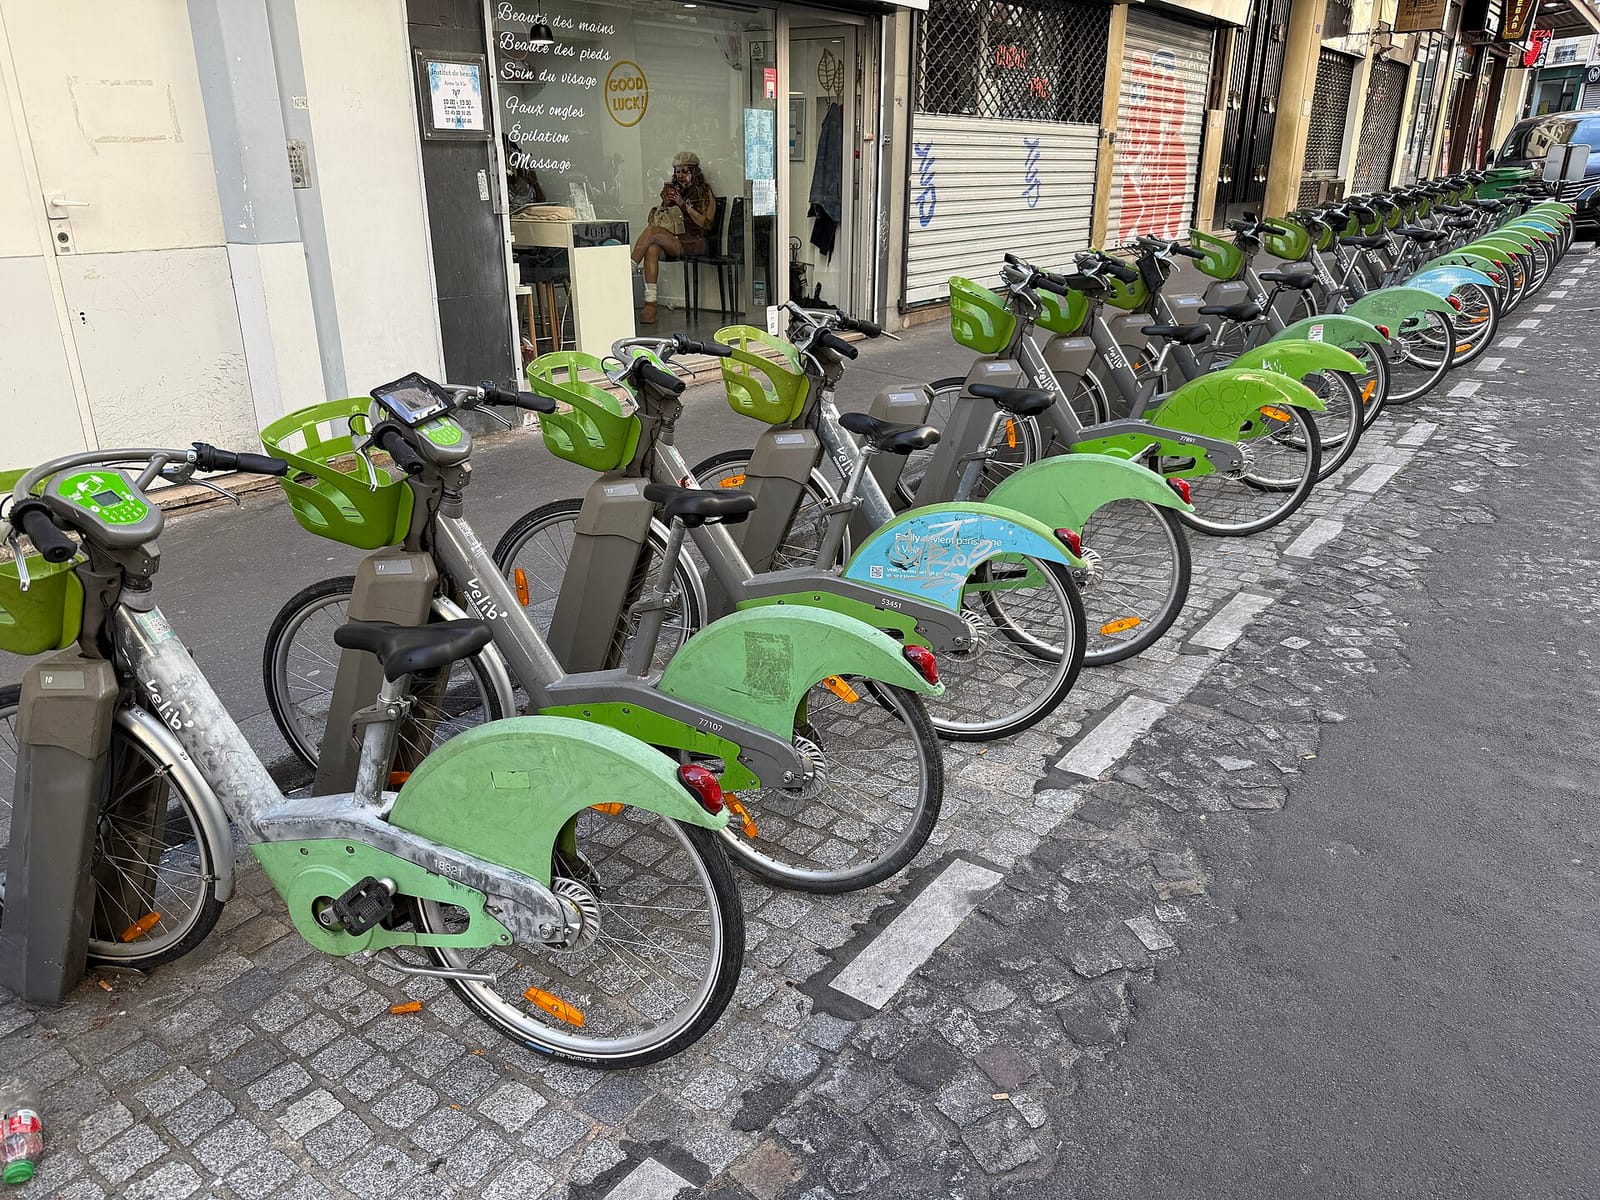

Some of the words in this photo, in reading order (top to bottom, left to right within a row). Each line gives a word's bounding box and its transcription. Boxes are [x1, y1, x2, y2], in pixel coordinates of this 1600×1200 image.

[498, 2, 548, 25] Beauté
[553, 15, 574, 29] des
[579, 22, 616, 35] mains
[554, 43, 576, 56] des
[580, 48, 612, 61] pieds
[500, 62, 534, 80] Soin
[539, 69, 556, 82] du
[561, 73, 597, 90] visage
[609, 77, 644, 91] GOOD
[506, 96, 545, 116] Faux
[549, 105, 586, 120] ongles
[613, 96, 645, 110] LUCK!
[508, 121, 570, 144] Épilation
[509, 152, 571, 174] Massage
[881, 598, 902, 609] 53451
[44, 676, 53, 684] 10
[698, 717, 723, 732] 77107
